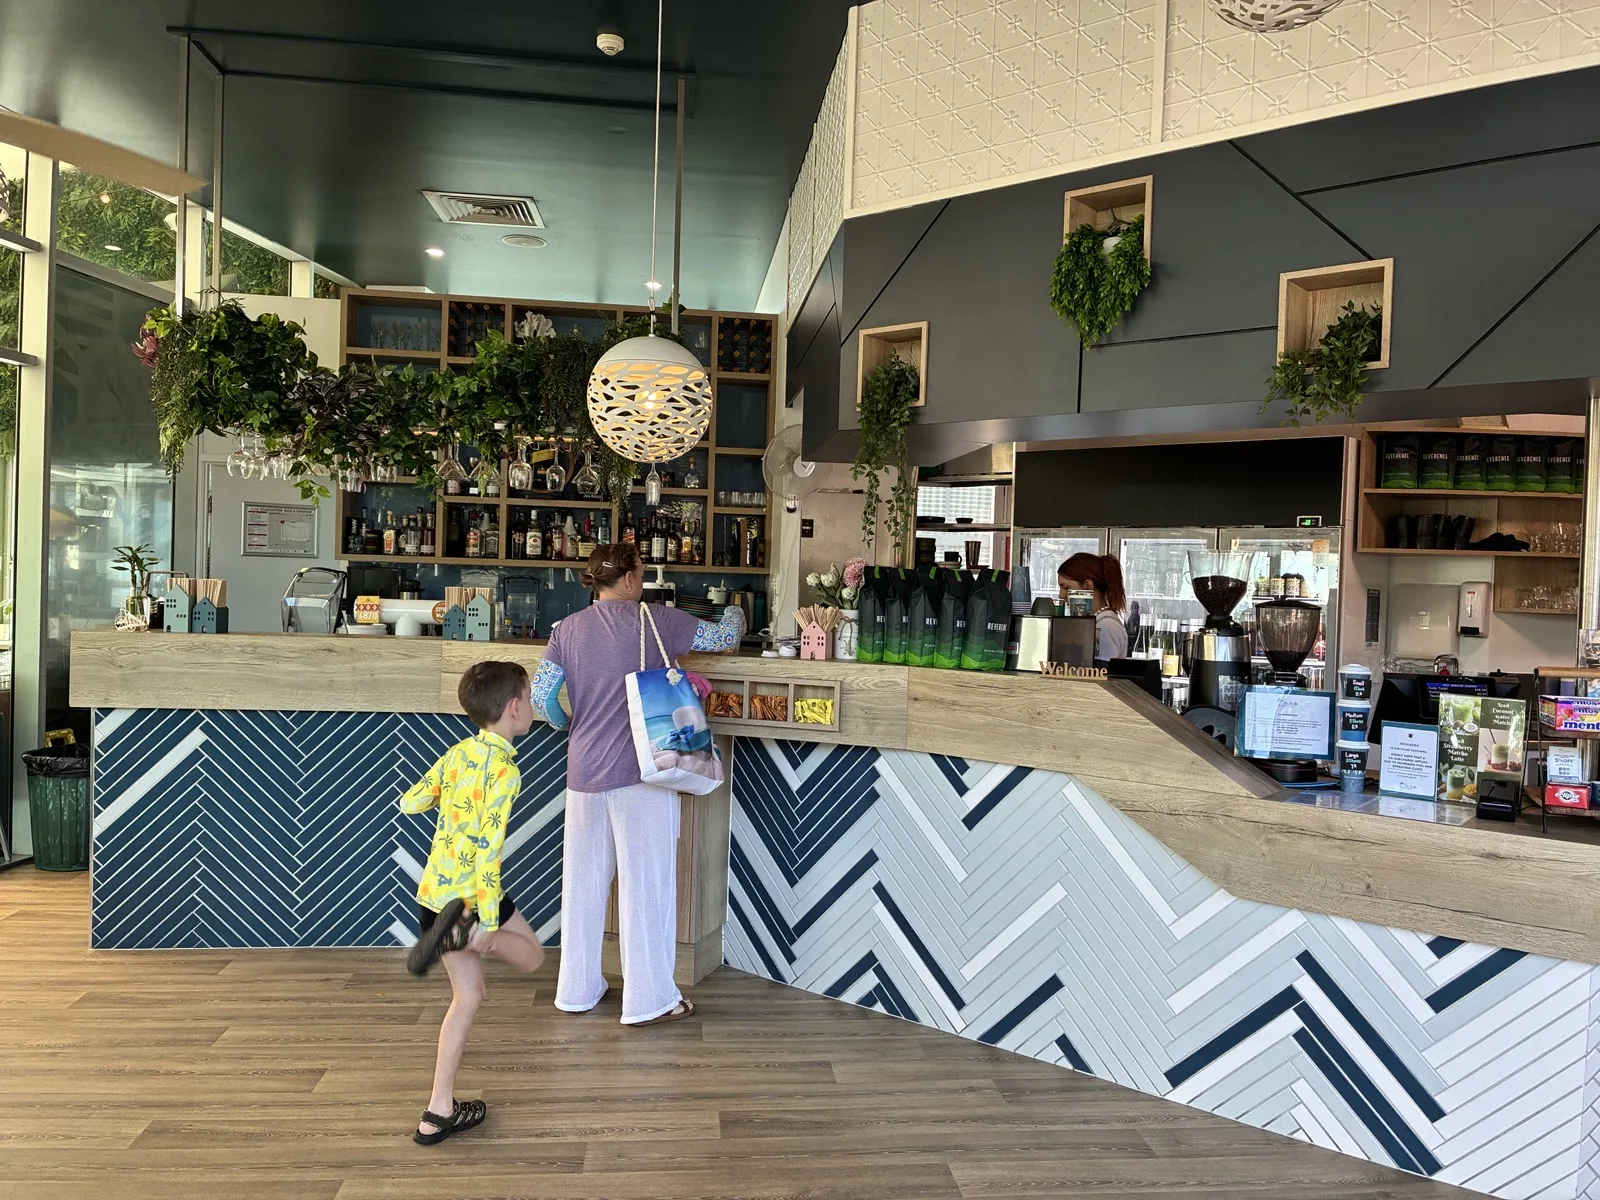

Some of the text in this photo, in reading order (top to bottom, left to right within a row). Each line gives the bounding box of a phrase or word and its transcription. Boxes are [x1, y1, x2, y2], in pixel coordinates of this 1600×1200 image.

[355, 603, 381, 612] XXXX
[1039, 660, 1108, 680] Welcome
[1563, 721, 1600, 730] ment
